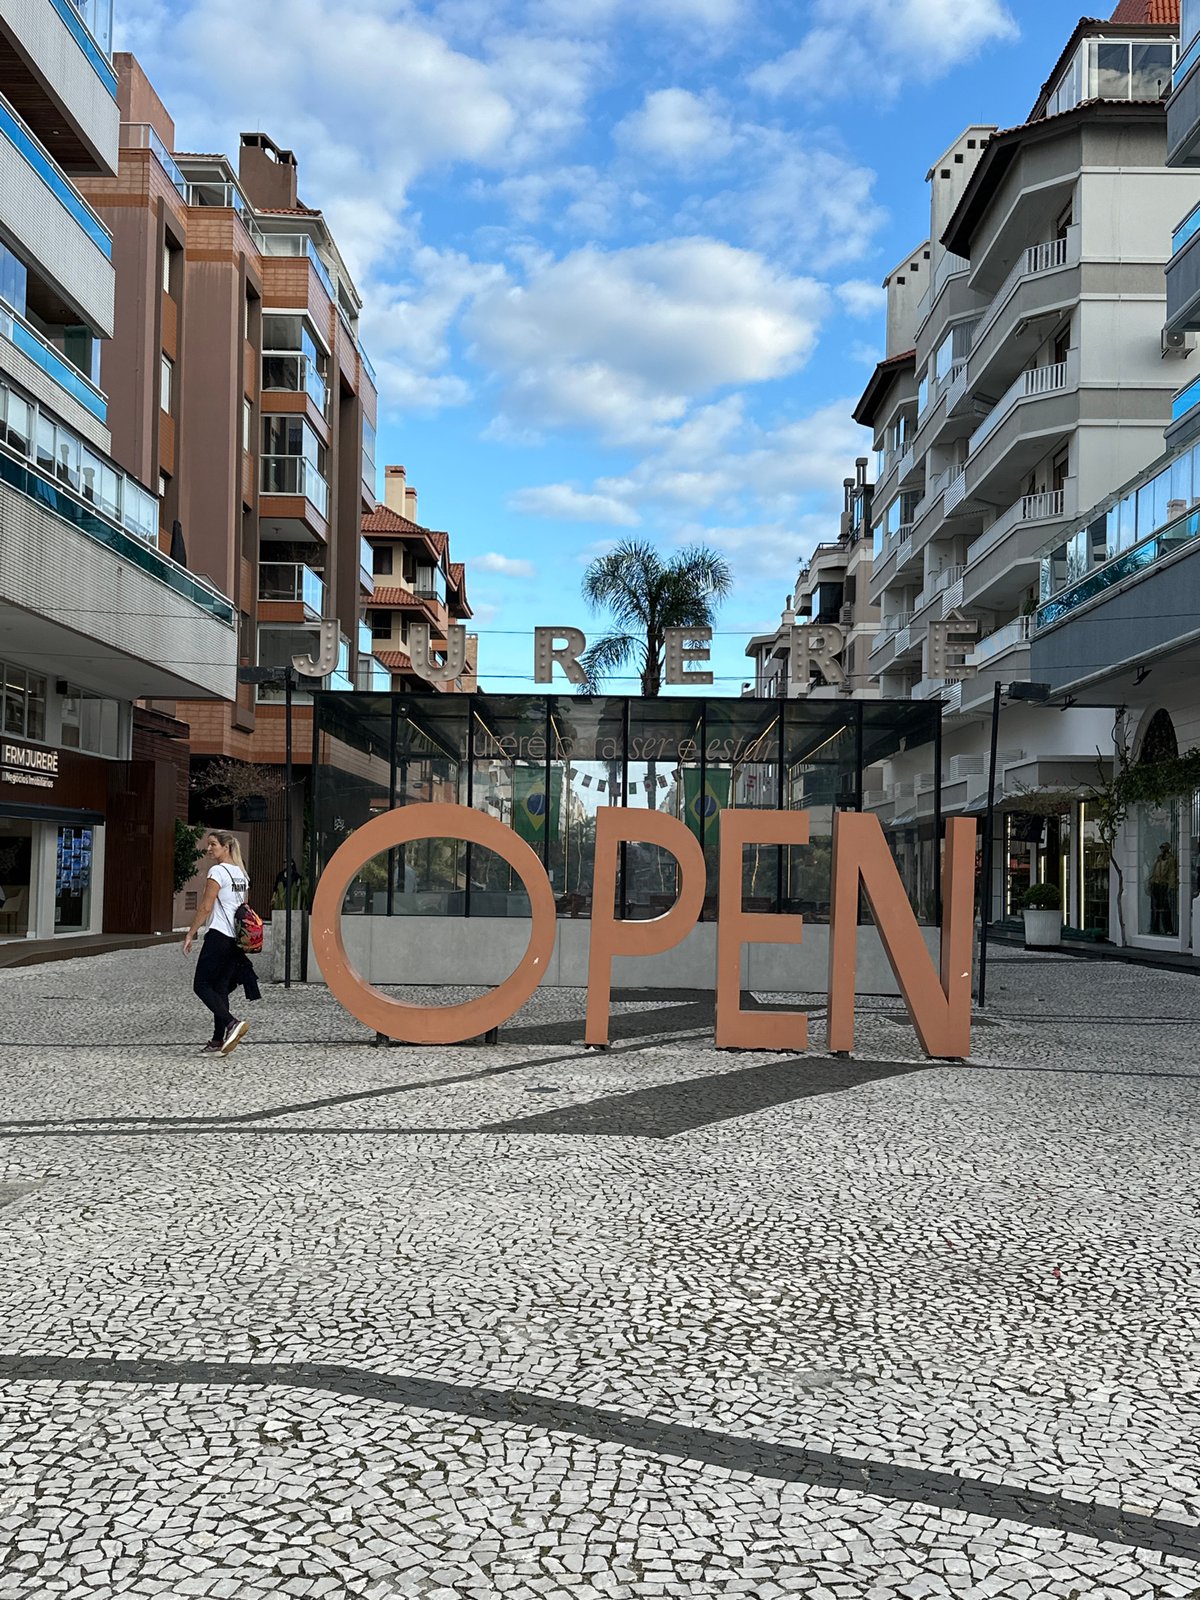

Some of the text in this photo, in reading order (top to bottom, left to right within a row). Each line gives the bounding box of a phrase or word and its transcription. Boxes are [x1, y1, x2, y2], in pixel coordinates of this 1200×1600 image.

[25, 749, 59, 772] JURERÊ
[628, 737, 673, 760] ser
[677, 739, 697, 760] e
[705, 735, 780, 762] estar
[312, 802, 975, 1060] OPEN
